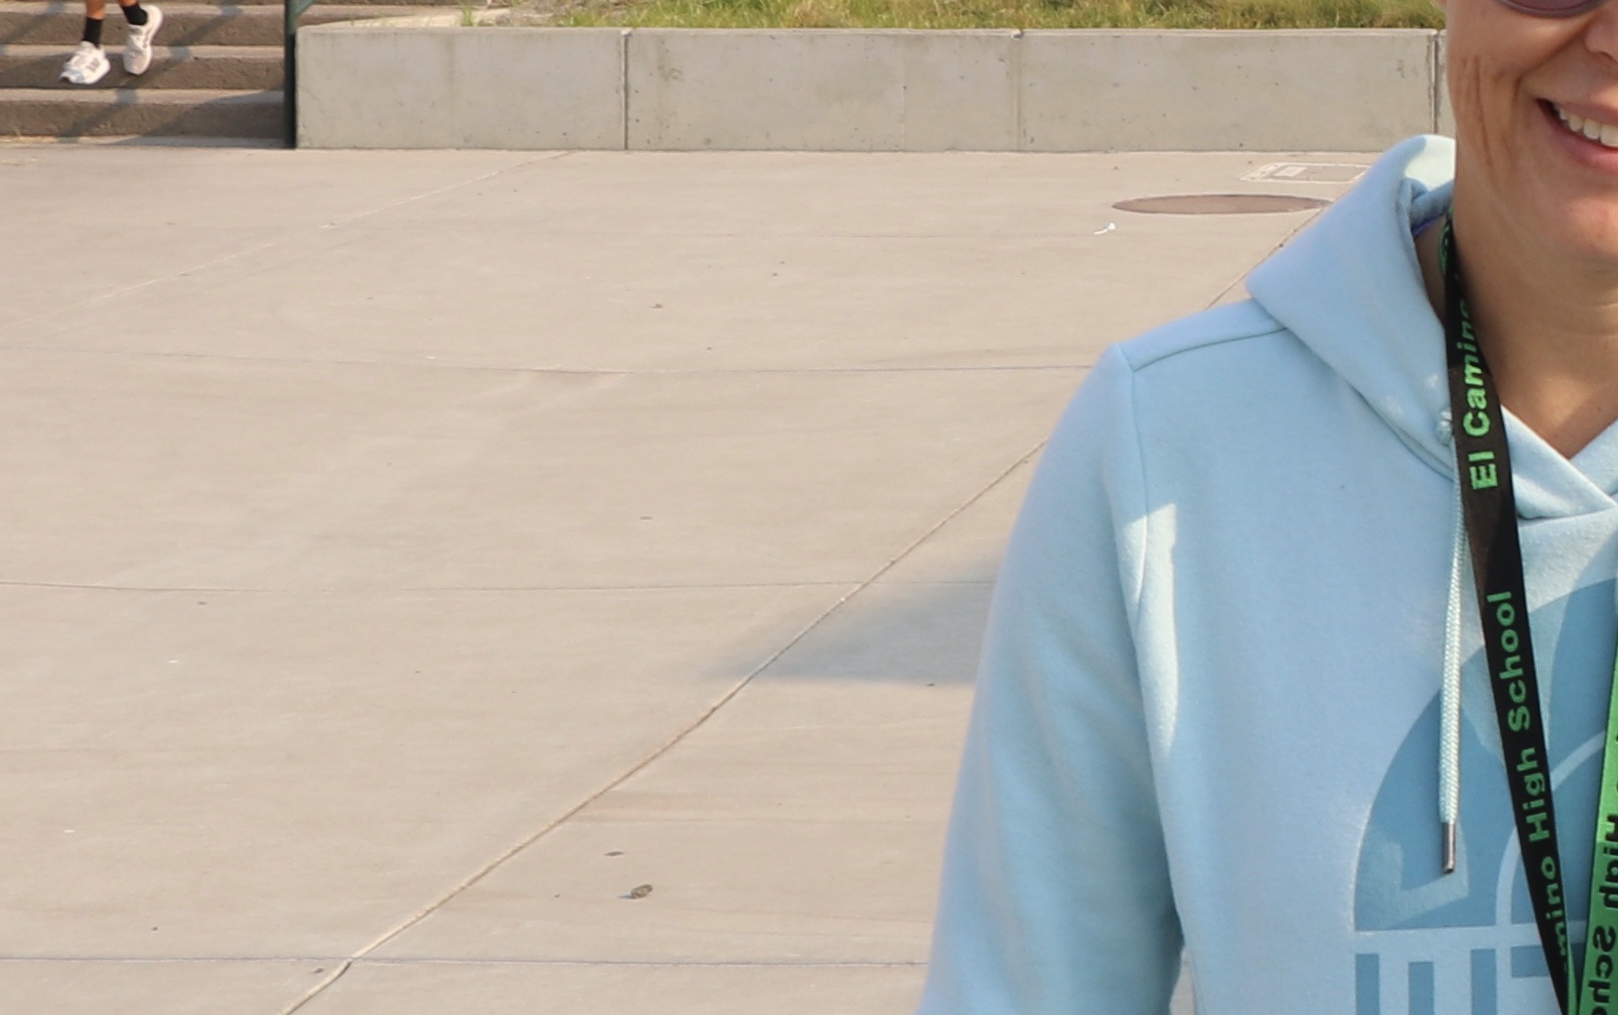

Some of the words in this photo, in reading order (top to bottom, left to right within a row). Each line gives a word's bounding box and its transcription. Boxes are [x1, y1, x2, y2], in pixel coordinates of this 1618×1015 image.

[1468, 451, 1498, 490] El
[1486, 591, 1531, 732] School
[1516, 747, 1551, 843] High
[1541, 856, 1568, 963] mino
